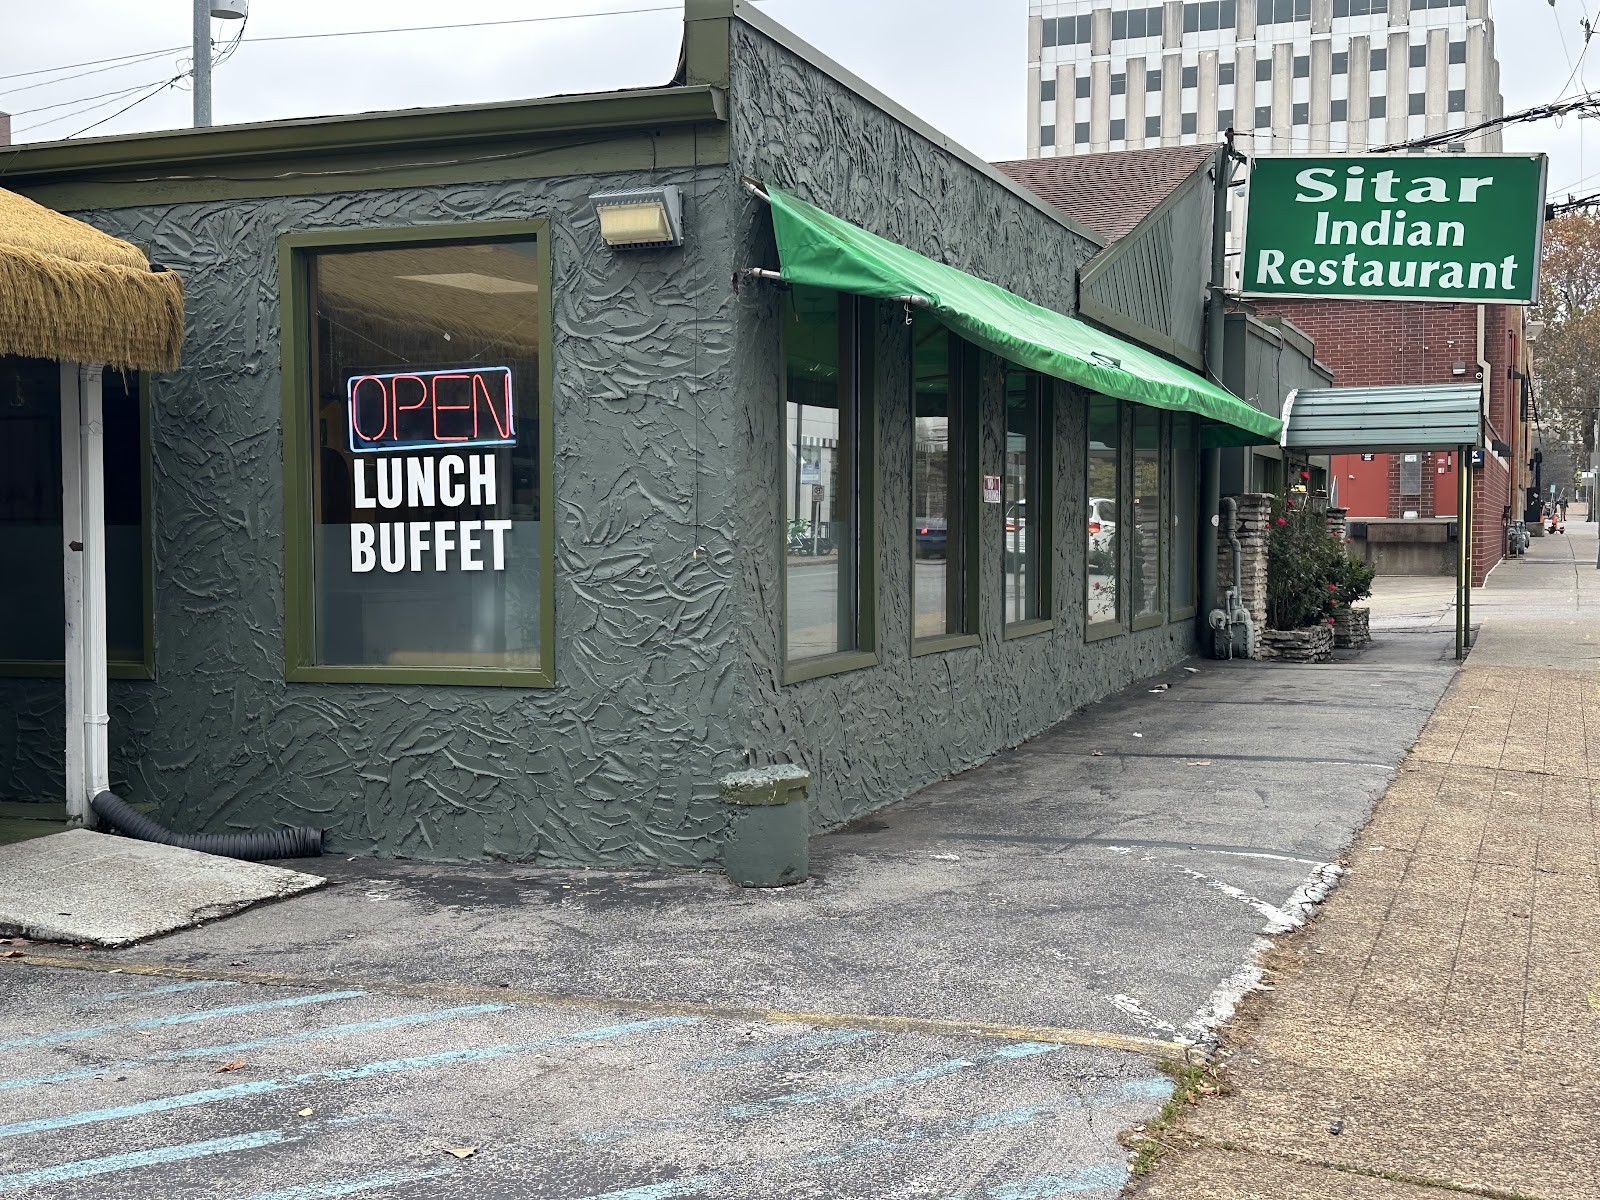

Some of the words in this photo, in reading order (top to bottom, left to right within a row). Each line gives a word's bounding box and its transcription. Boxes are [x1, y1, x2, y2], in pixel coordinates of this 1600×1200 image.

[1295, 165, 1494, 203] Sitar
[1314, 209, 1465, 247] Indian
[1256, 249, 1518, 290] Restaurant
[352, 374, 510, 441] OPEN
[353, 454, 497, 509] LUNCH
[350, 519, 512, 573] BUFFET
